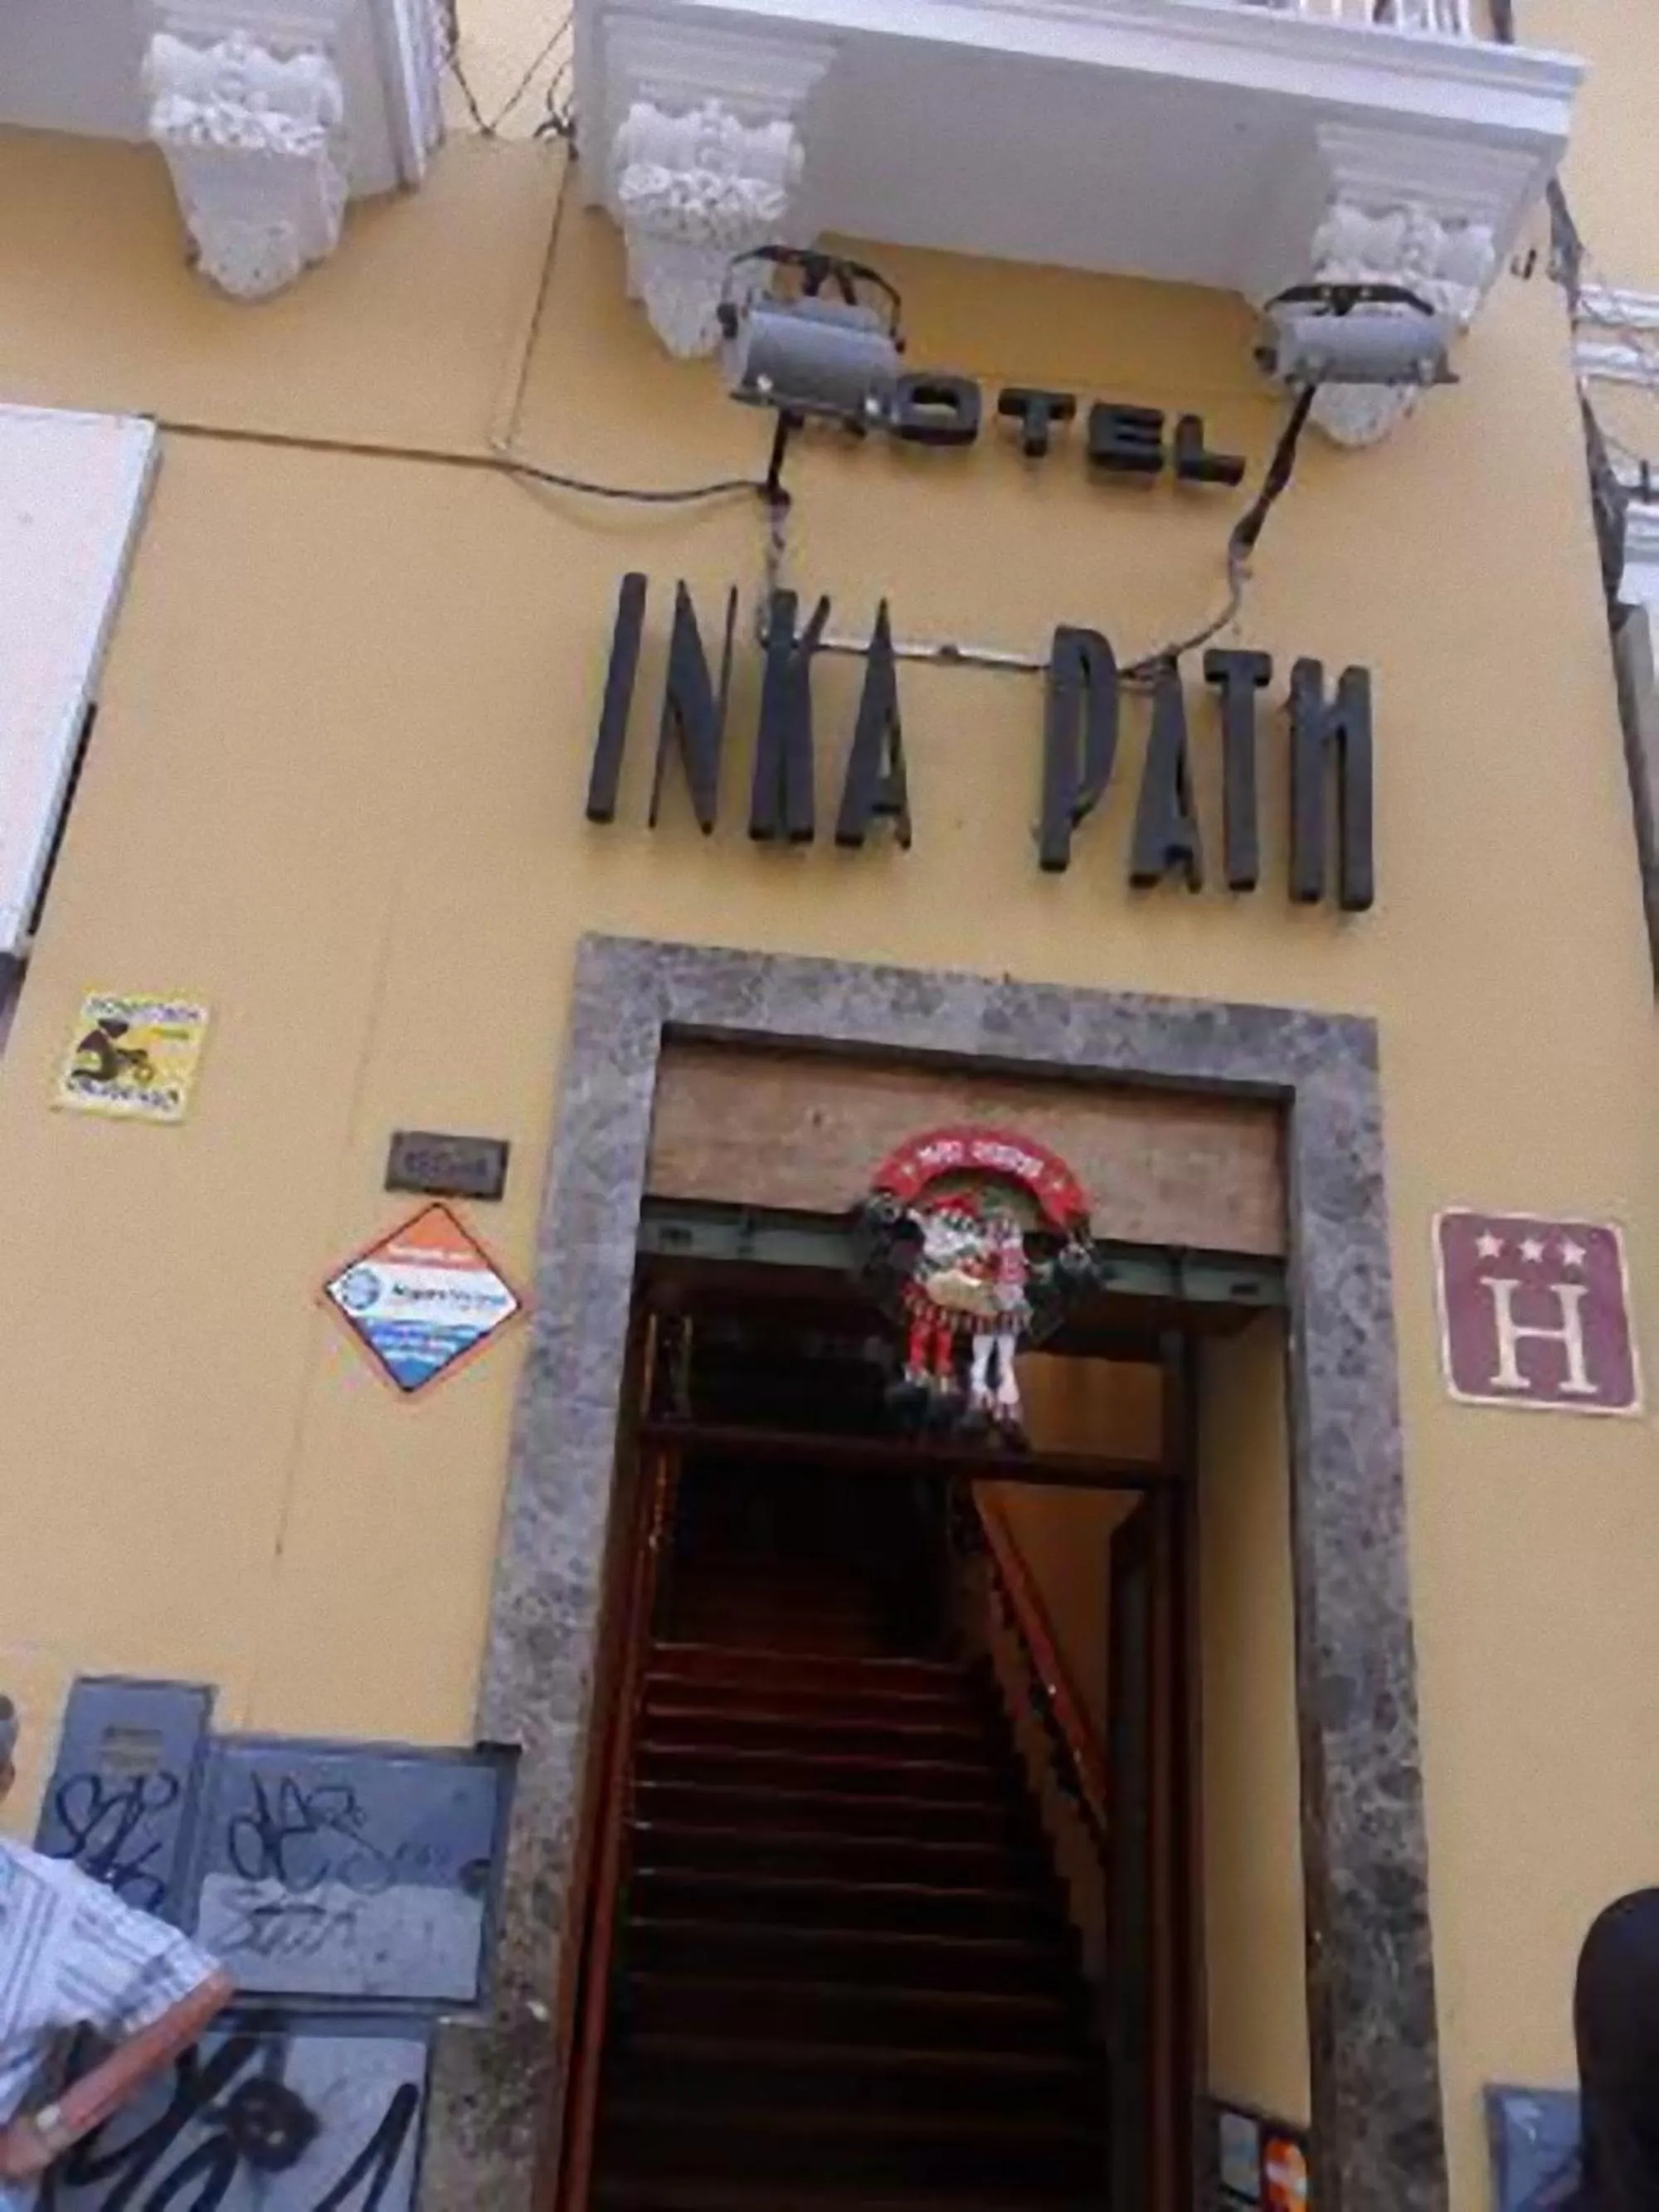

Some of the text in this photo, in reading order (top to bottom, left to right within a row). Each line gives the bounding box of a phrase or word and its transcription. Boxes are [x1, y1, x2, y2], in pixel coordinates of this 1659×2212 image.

[781, 372, 1246, 488] OTEL
[586, 572, 1374, 912] INKA PATH
[1479, 1276, 1599, 1394] H
